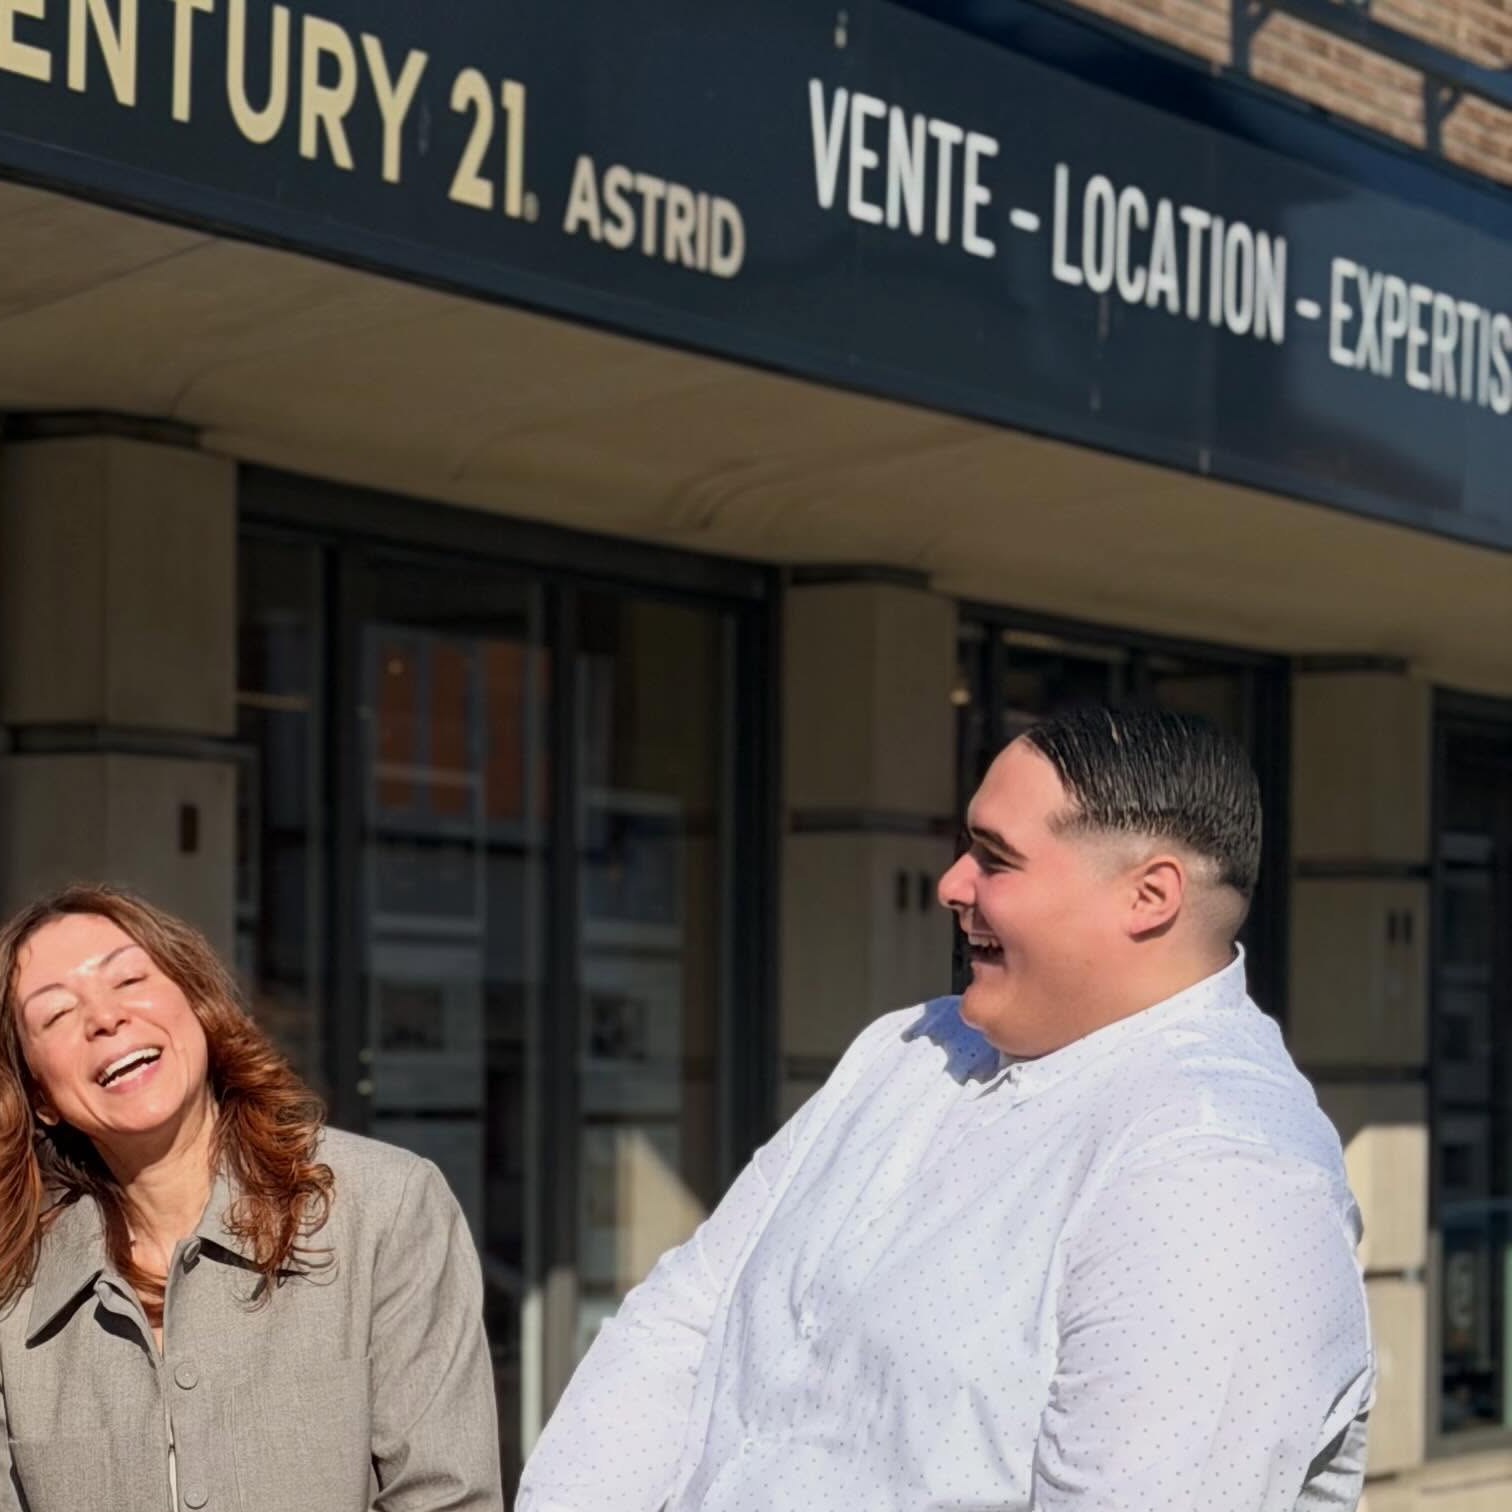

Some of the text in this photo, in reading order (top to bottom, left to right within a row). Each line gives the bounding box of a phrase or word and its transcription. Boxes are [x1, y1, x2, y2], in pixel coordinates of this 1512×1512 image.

[562, 154, 746, 279] ASTRID
[807, 78, 999, 259] VENTE
[1051, 162, 1287, 345] LOCATION
